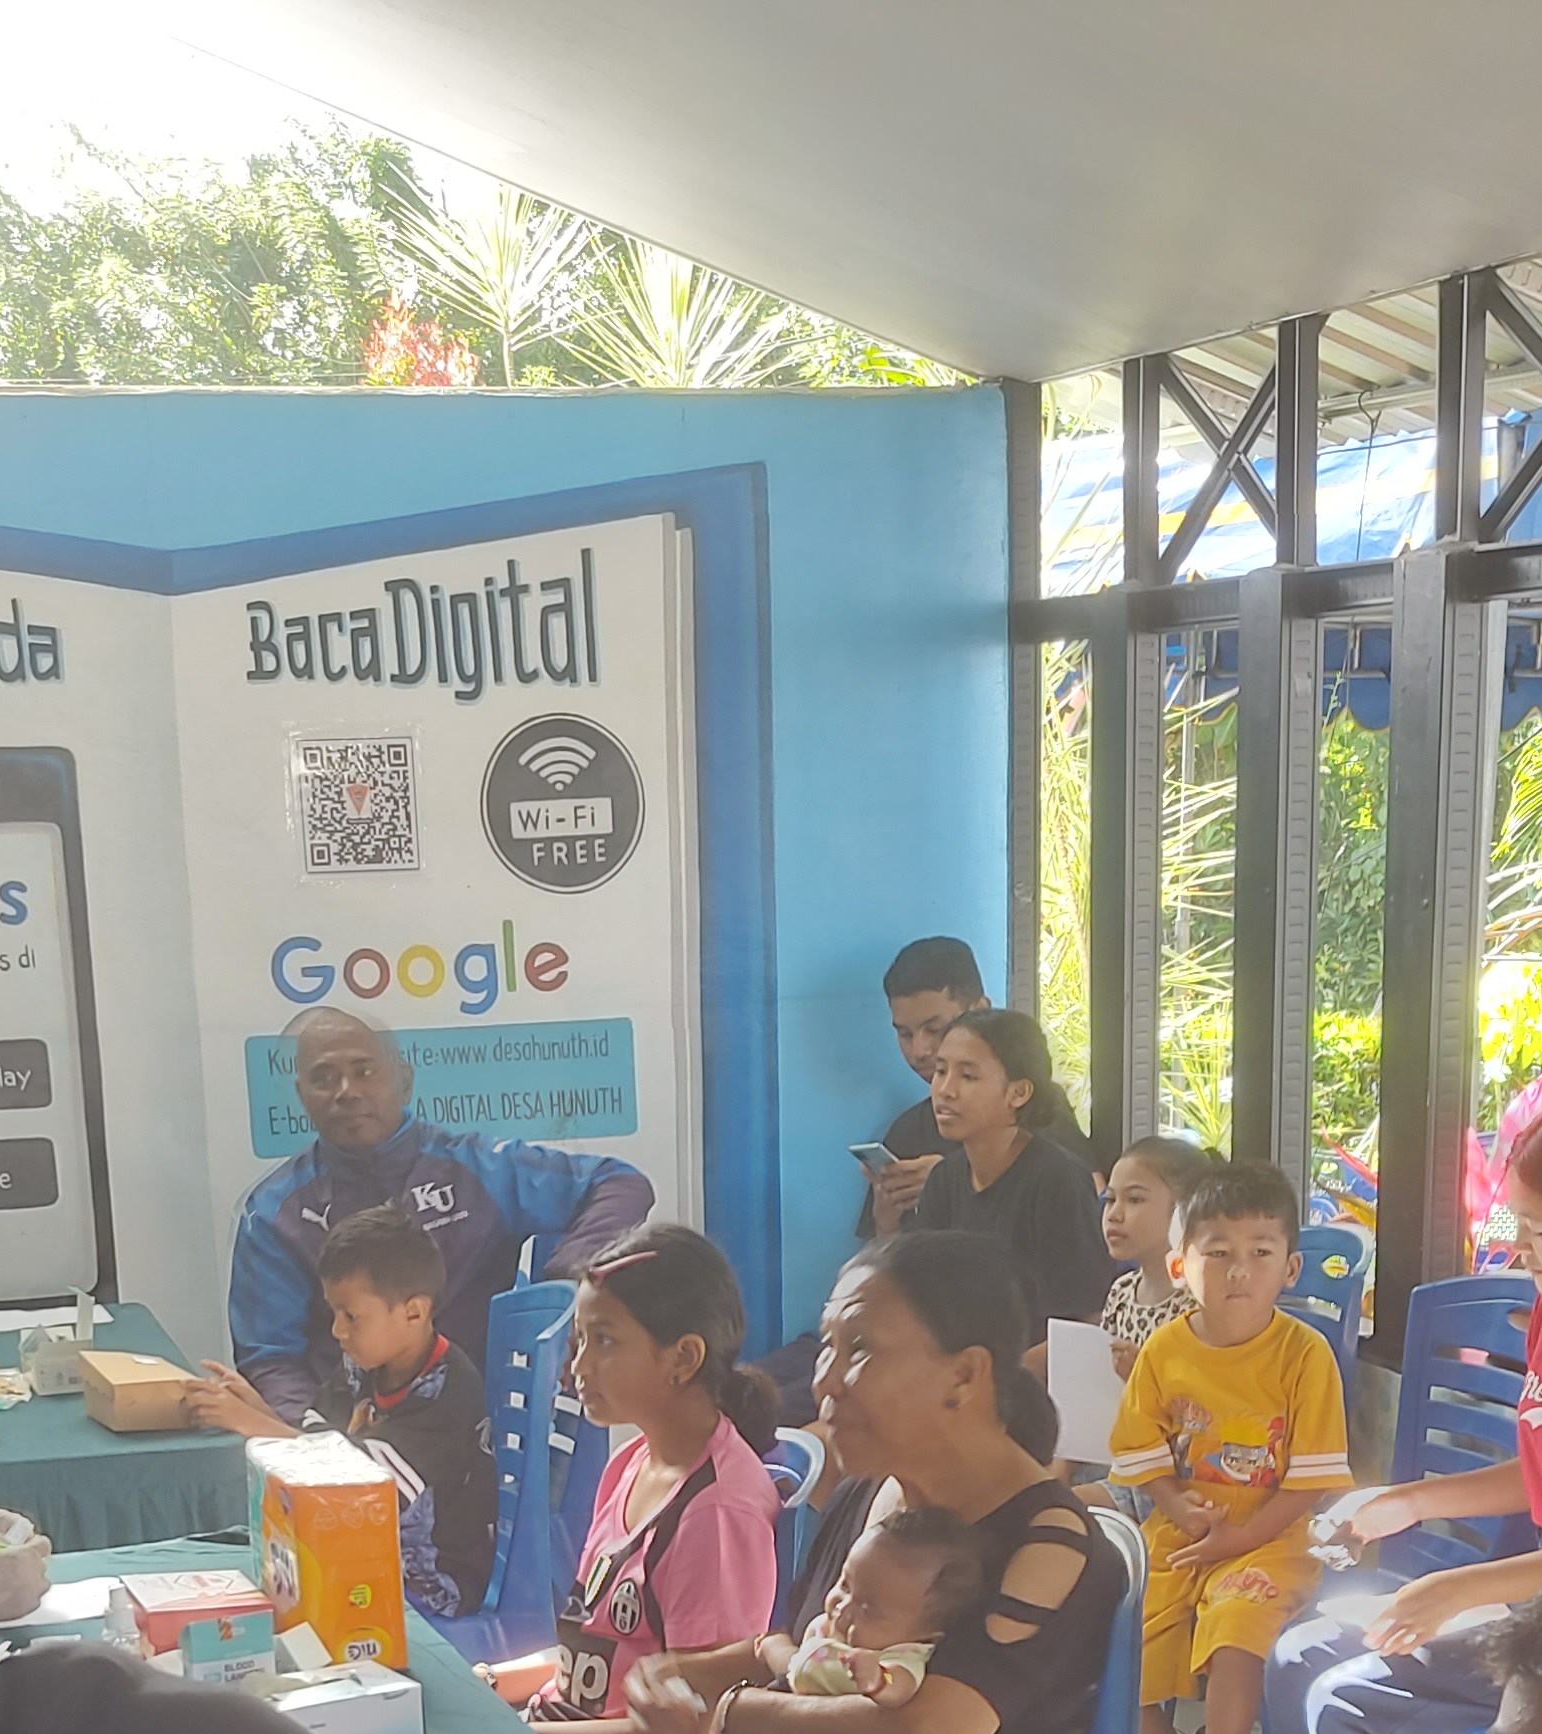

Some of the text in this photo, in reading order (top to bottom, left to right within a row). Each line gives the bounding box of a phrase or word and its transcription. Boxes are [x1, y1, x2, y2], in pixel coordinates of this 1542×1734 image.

[532, 839, 607, 867] FREE
[271, 919, 570, 1015] Google
[434, 1094, 498, 1124] DIGITAL
[501, 1090, 545, 1120] DESA
[550, 1086, 623, 1118] HUNUTH
